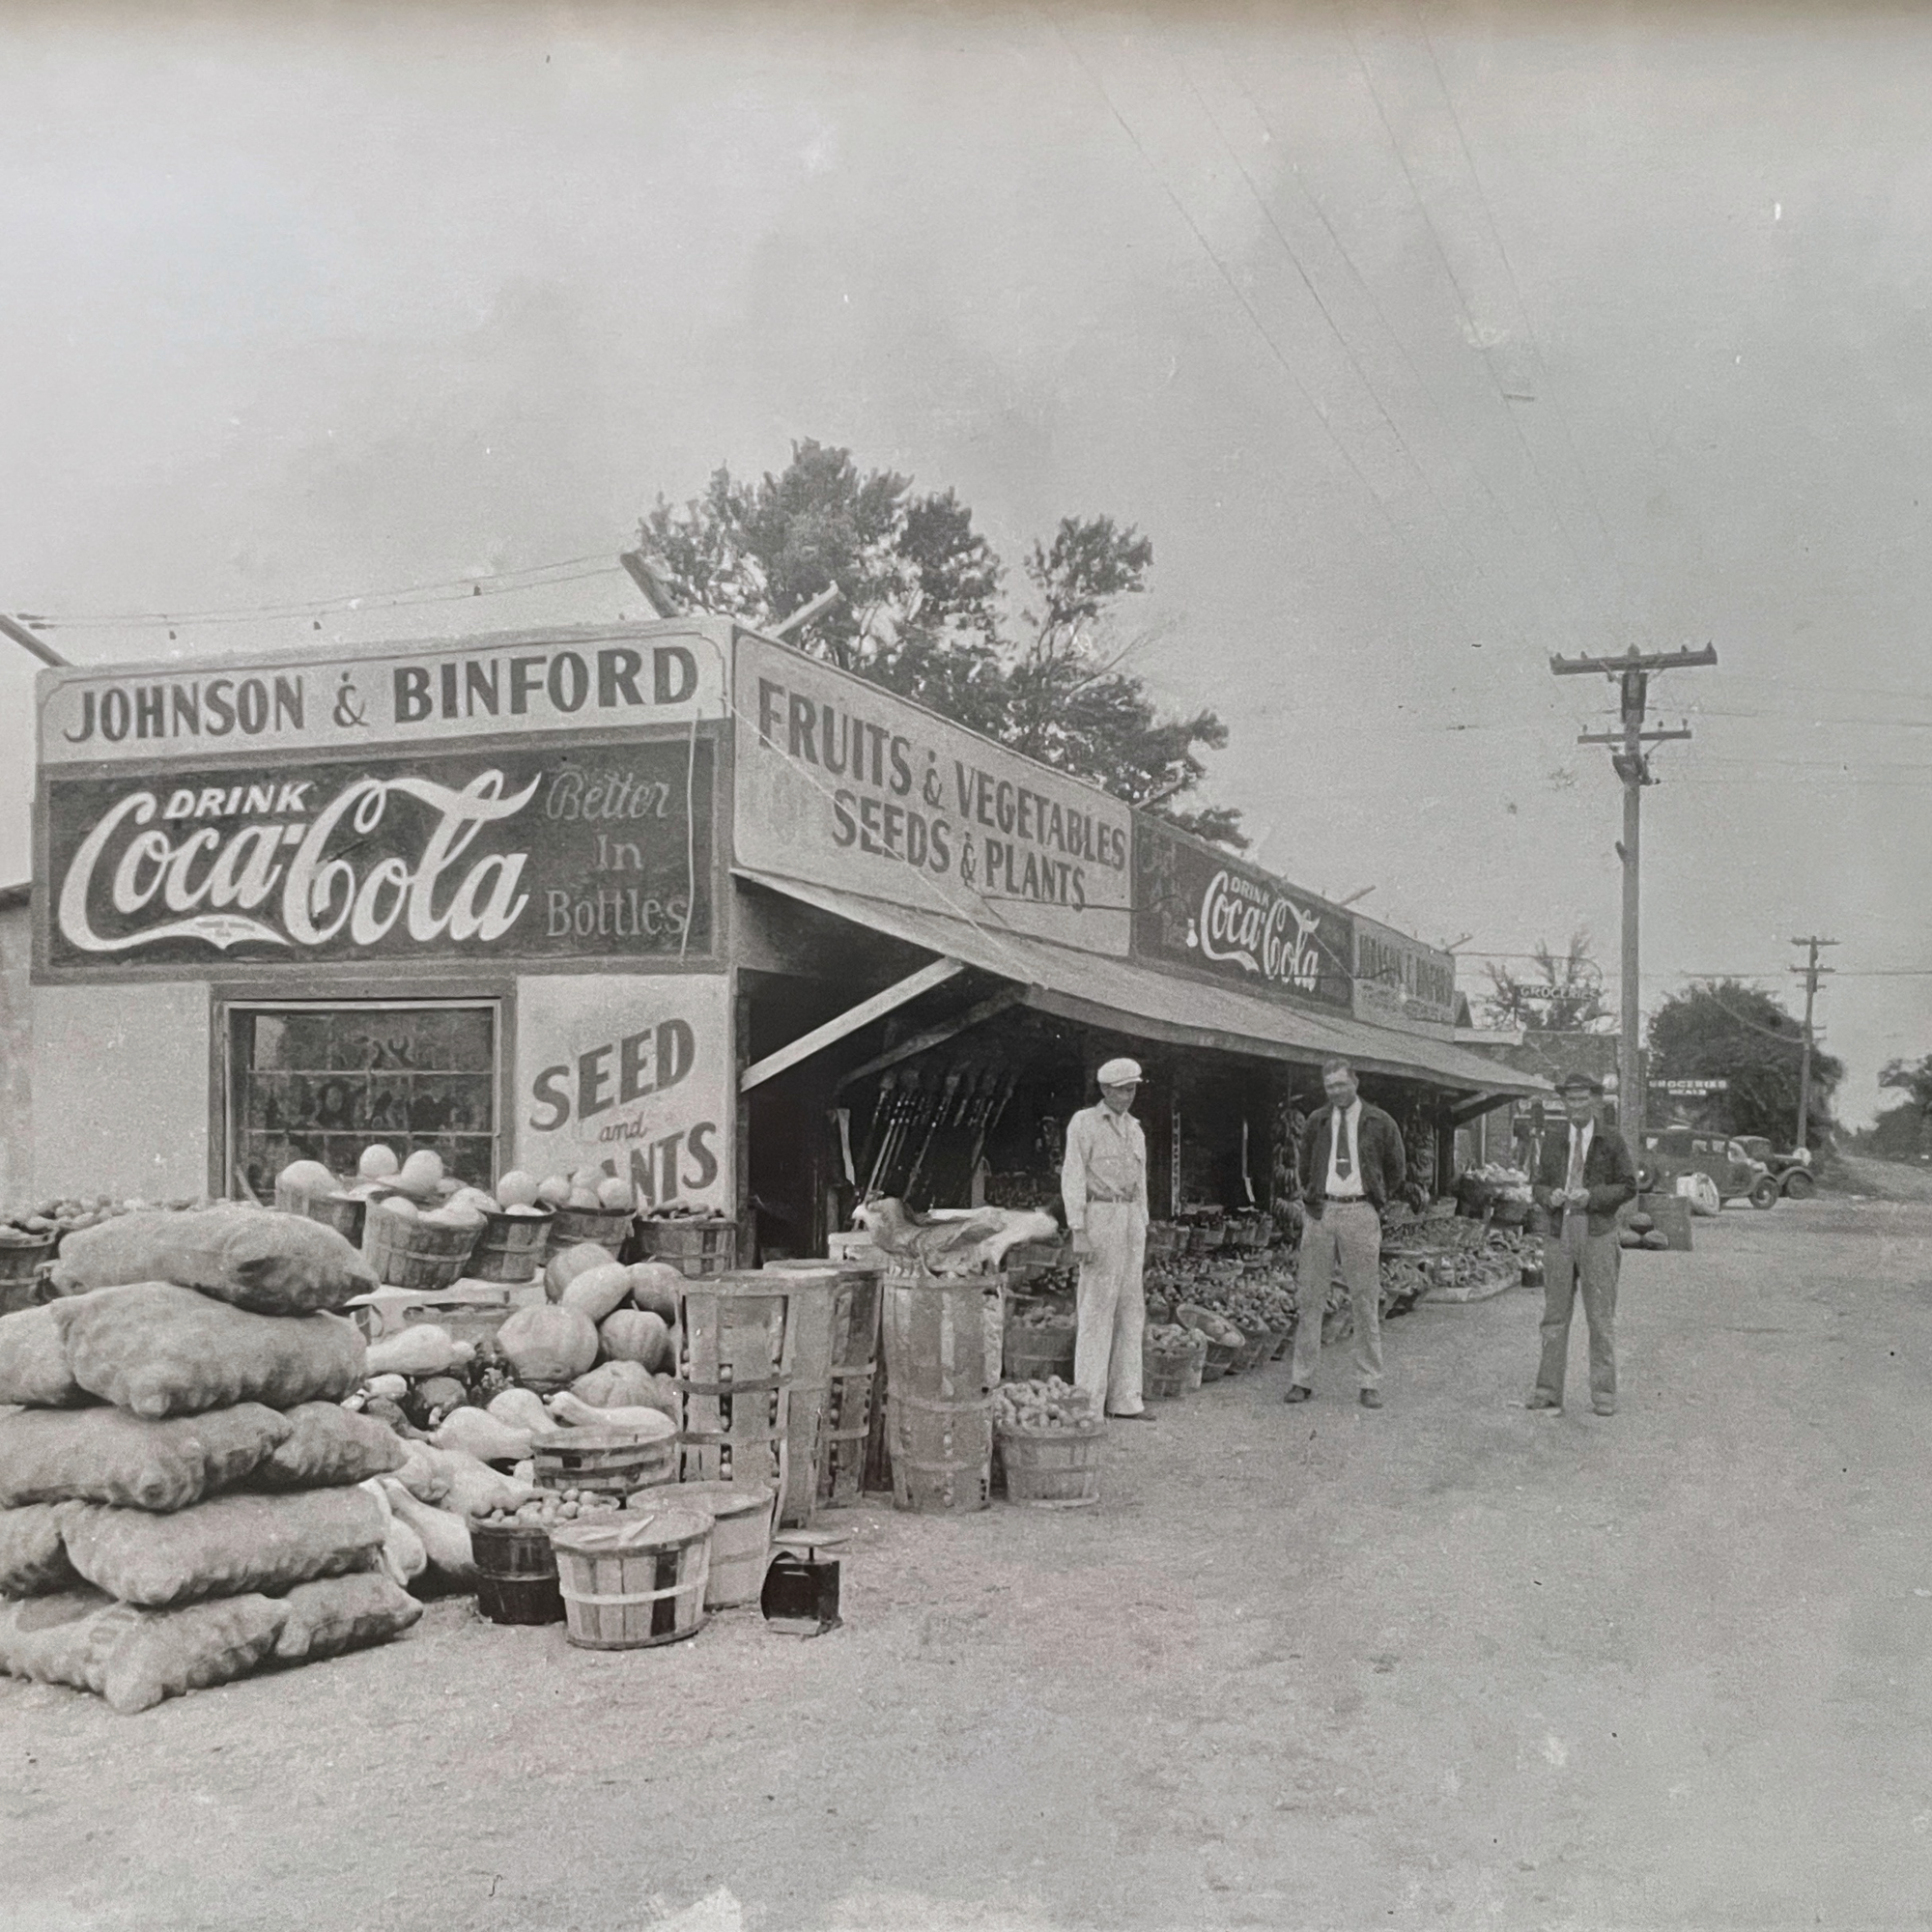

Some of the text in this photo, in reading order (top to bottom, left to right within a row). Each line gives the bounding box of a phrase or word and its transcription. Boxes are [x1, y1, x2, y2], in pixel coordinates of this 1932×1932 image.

[63, 646, 699, 743] JOHNSON & BINFORD
[164, 782, 314, 821] DRINK
[546, 770, 670, 820] Better
[758, 676, 1126, 870] FRUITS & VEGETABLES
[58, 769, 543, 952] Coca-Cola
[595, 834, 644, 870] In
[832, 788, 952, 874] SEEDS
[960, 833, 978, 887] &
[985, 838, 1087, 909] PLANTS
[545, 888, 688, 936] Bottles
[1201, 870, 1321, 992] Coca-Cola
[1230, 876, 1270, 908] DRINK
[528, 1018, 696, 1133] SEED
[599, 1111, 649, 1143] and
[601, 1122, 719, 1208] NTS
